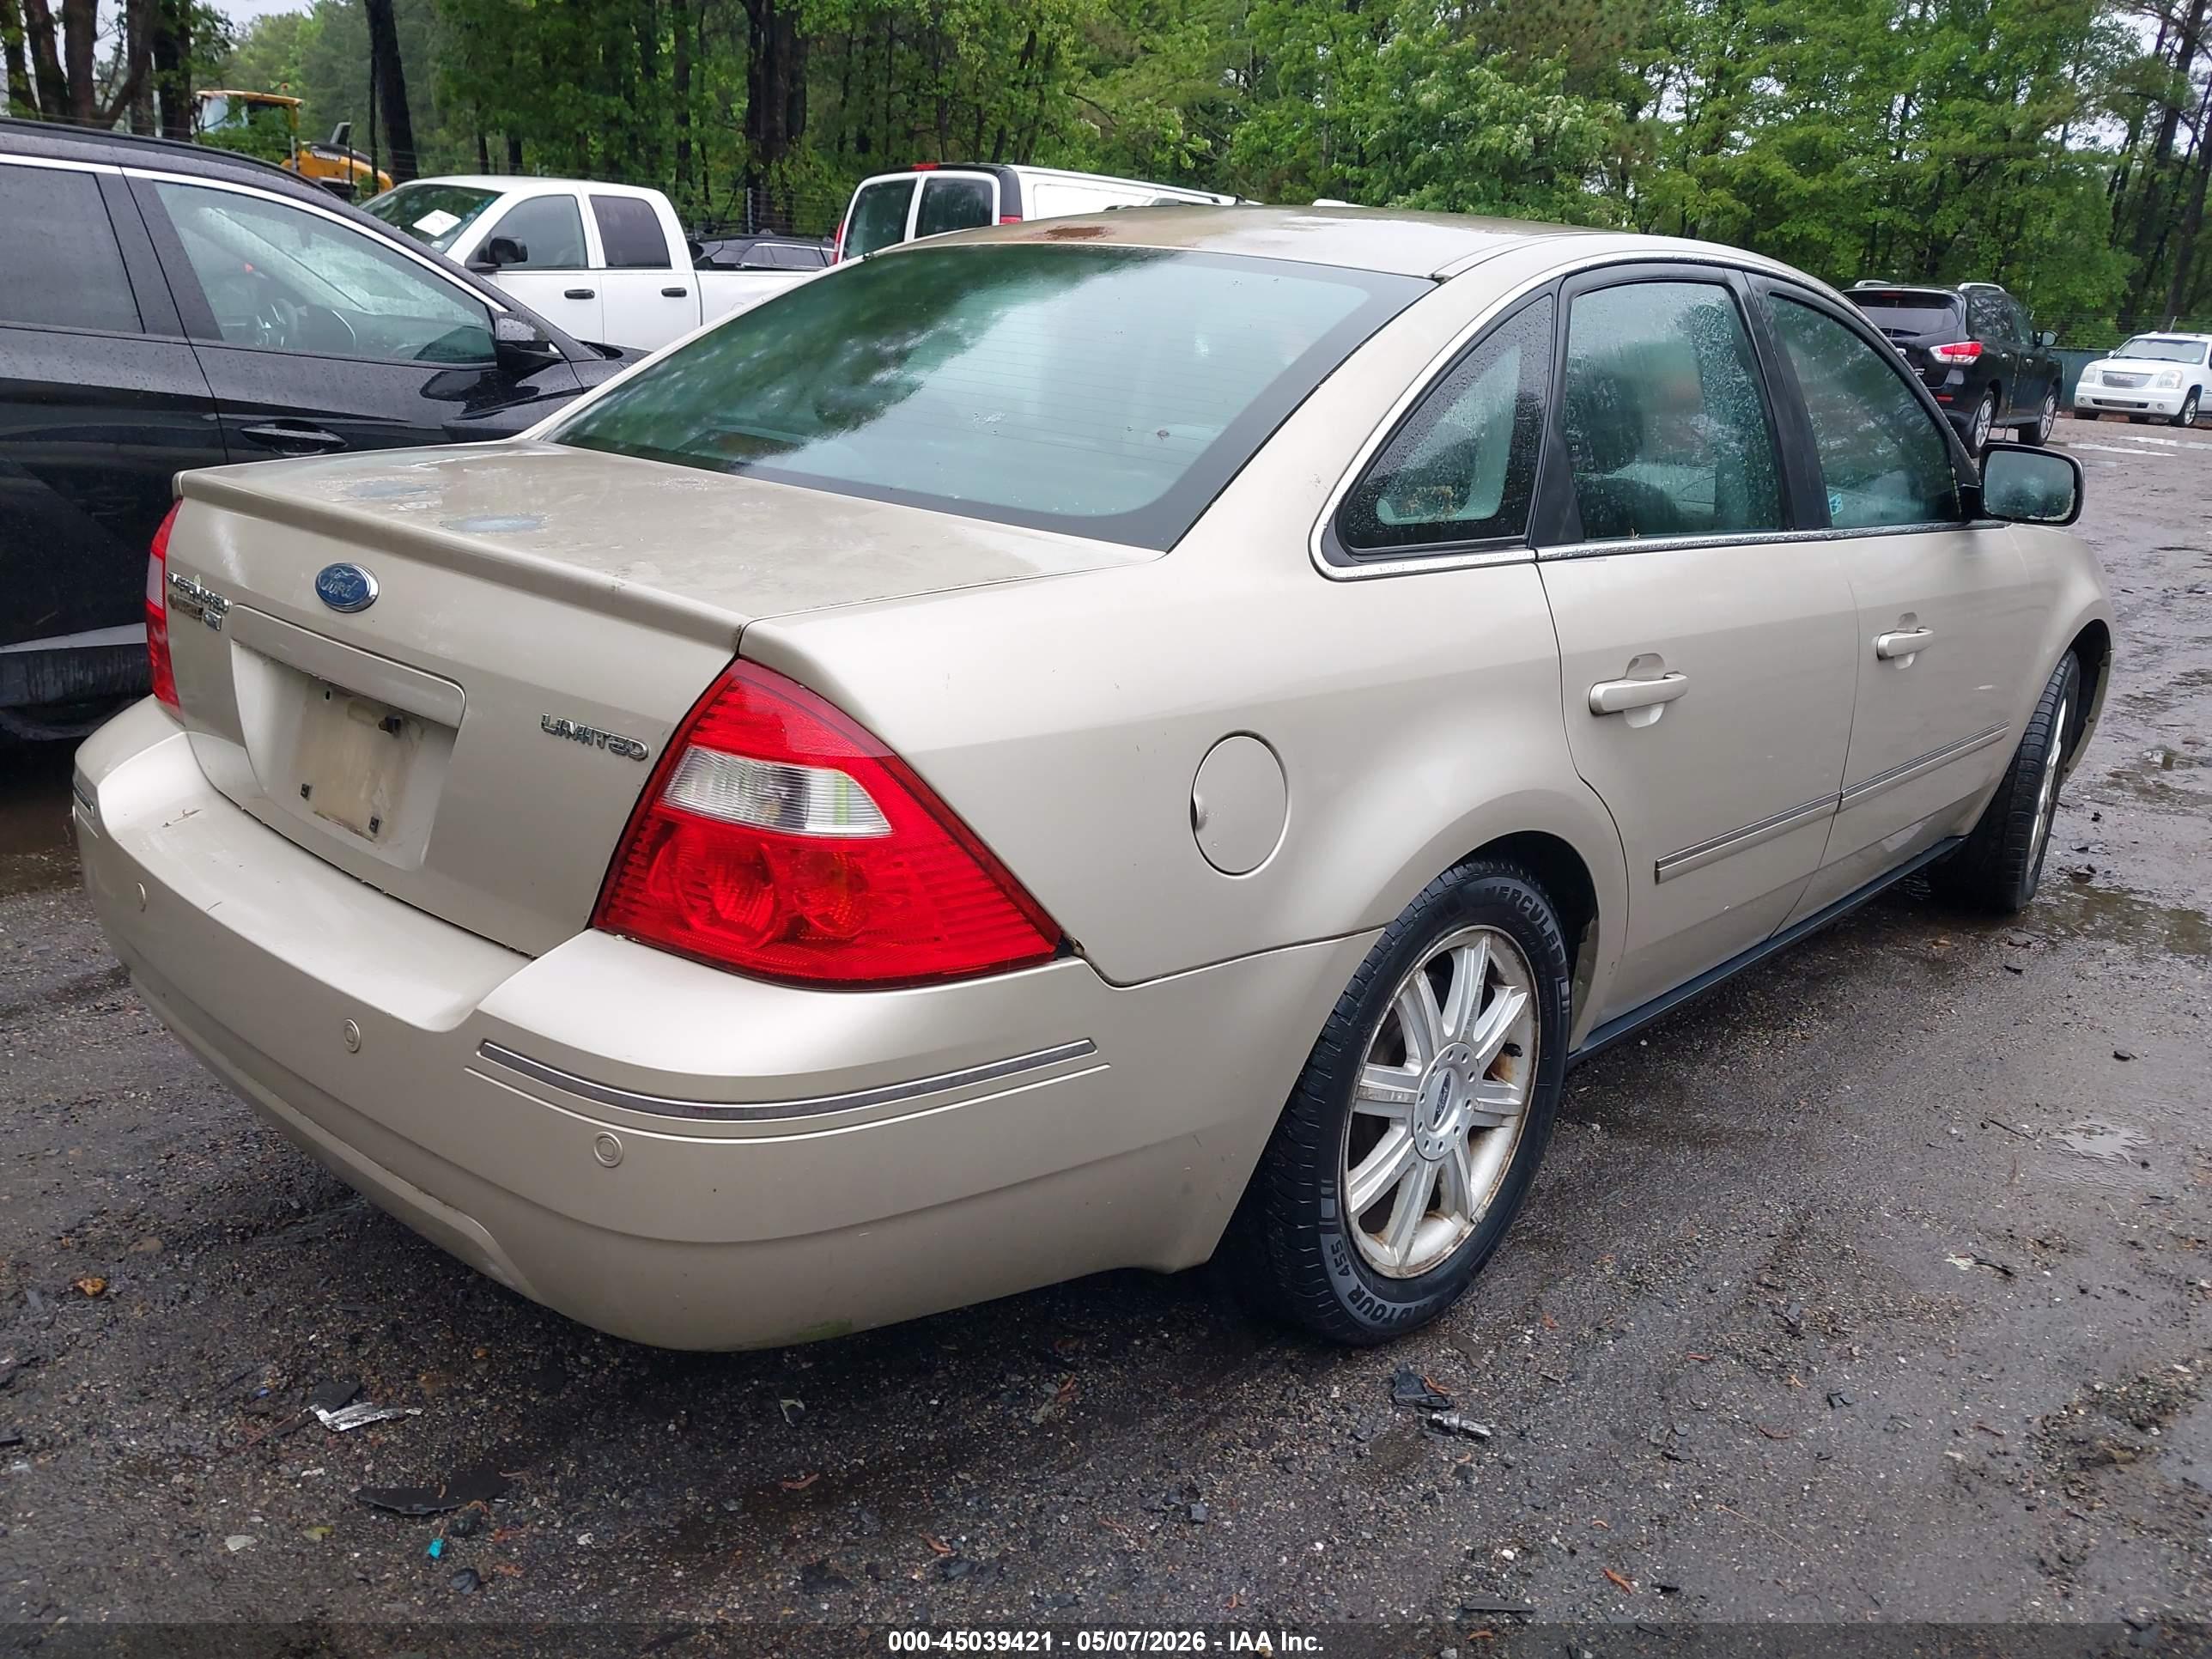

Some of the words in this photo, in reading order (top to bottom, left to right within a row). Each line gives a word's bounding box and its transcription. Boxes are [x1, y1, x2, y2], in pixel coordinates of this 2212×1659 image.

[319, 568, 358, 599] Ford
[541, 713, 650, 762] LIMITED
[1330, 1239, 1351, 1277] 455
